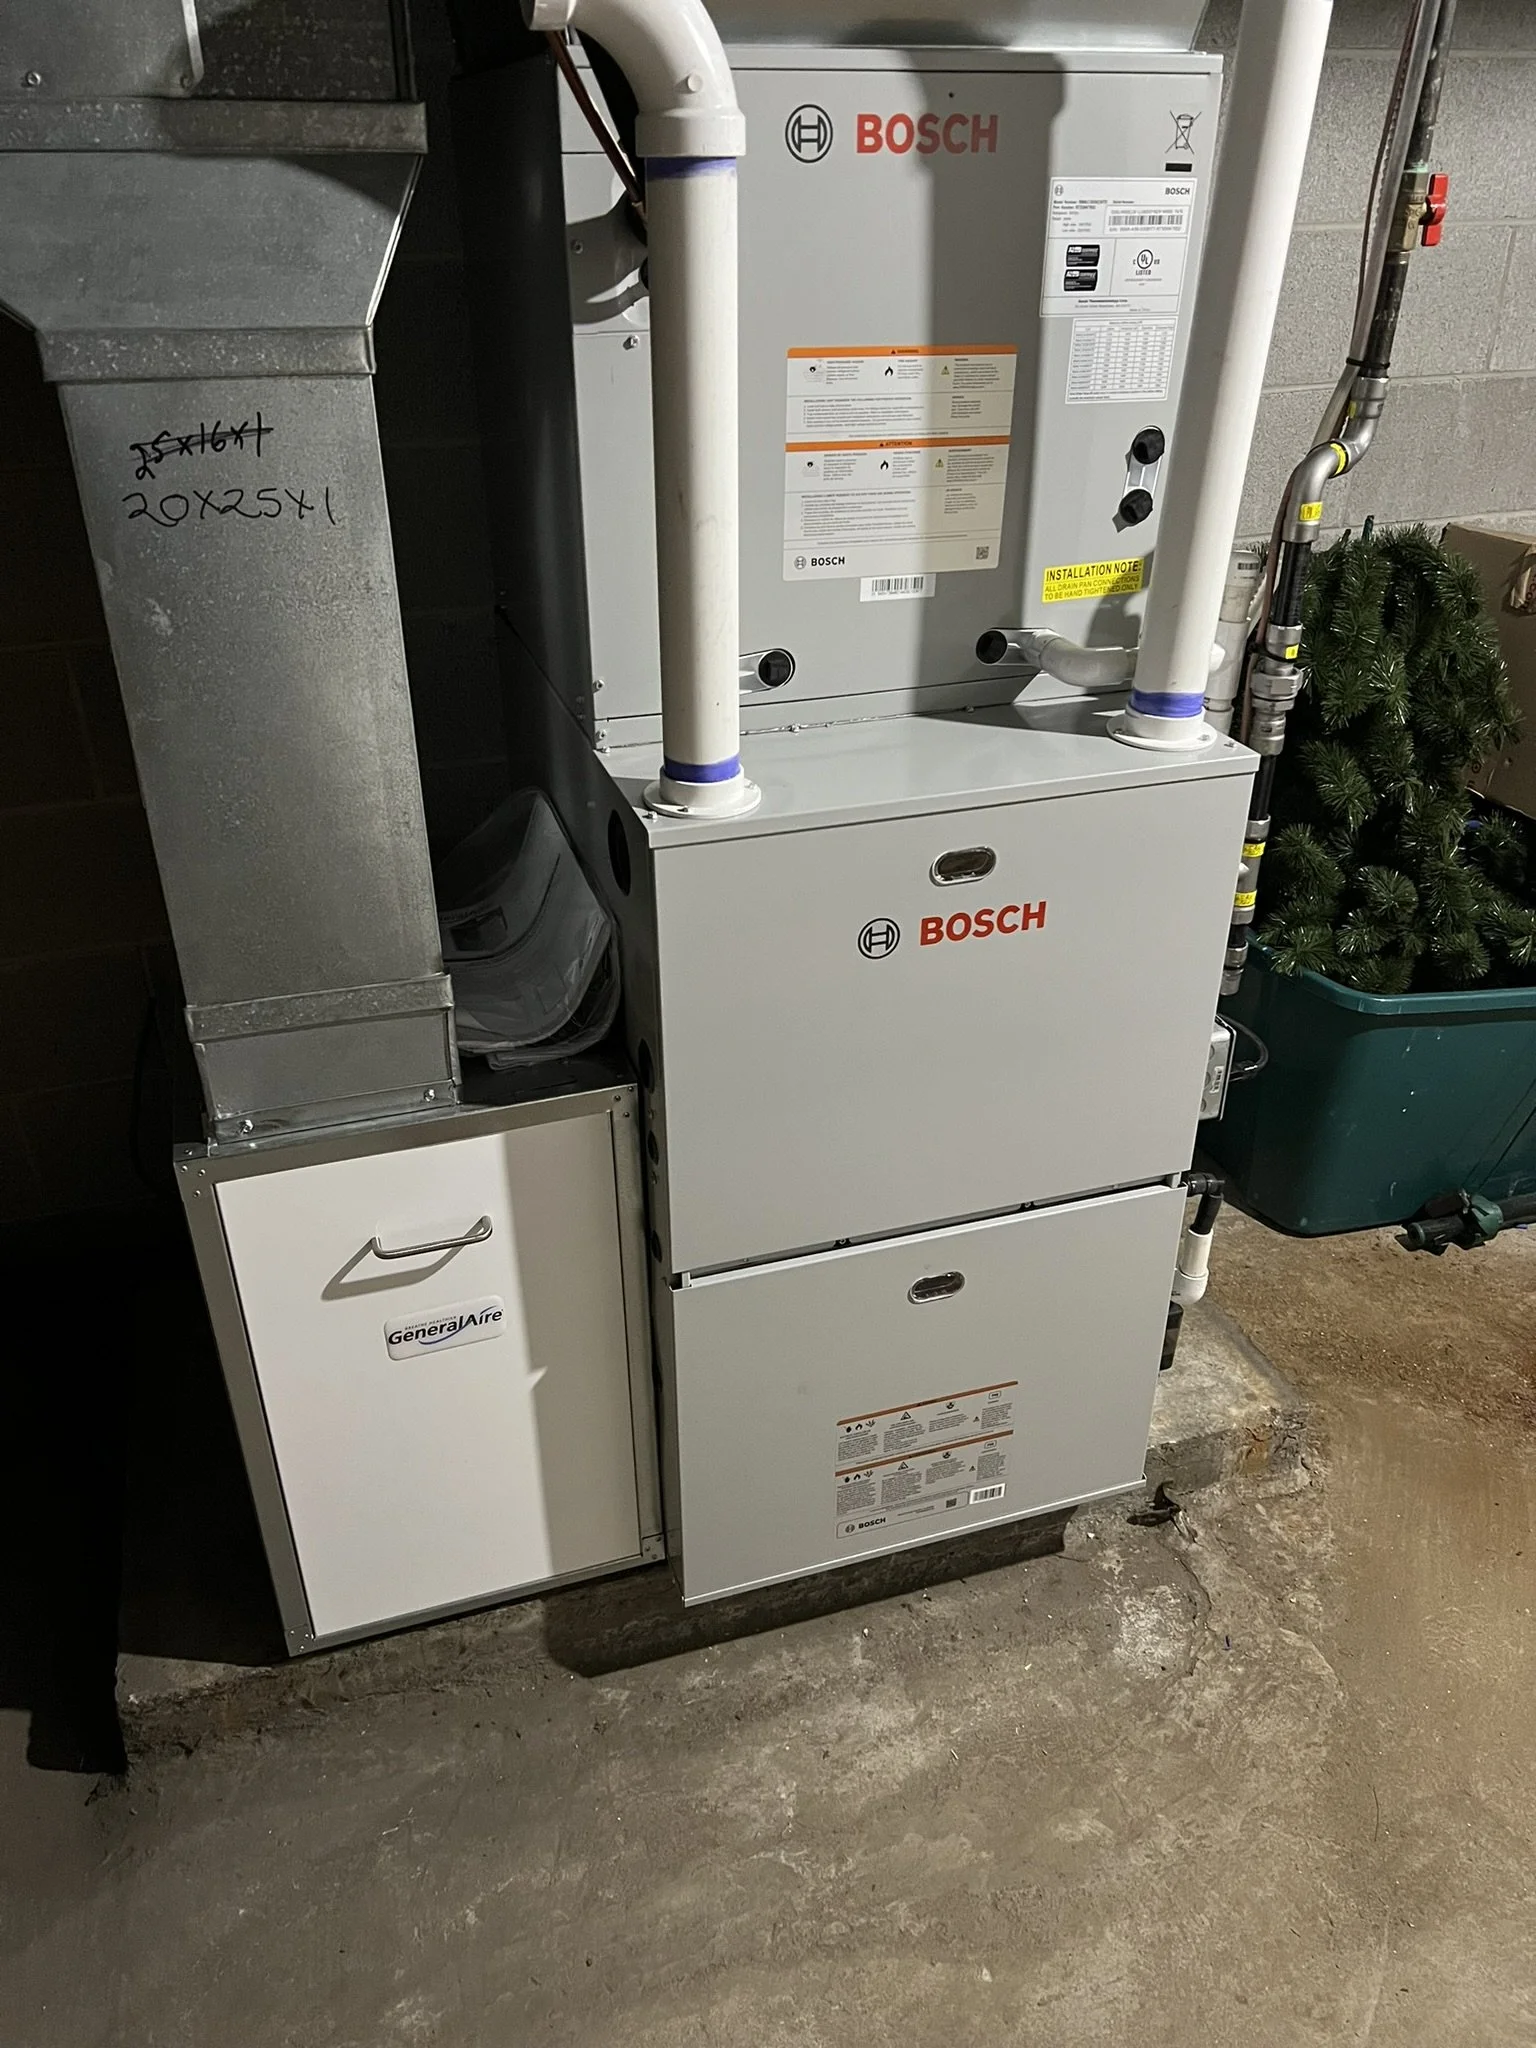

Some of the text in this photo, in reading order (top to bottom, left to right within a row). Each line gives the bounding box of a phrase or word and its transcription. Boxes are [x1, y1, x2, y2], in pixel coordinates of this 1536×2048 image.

[857, 113, 998, 154] BOSCH
[1165, 187, 1190, 196] BOSCH
[811, 556, 845, 567] BOSCH
[1045, 560, 1142, 582] INSTALLATION NOTE:
[1045, 575, 1140, 592] ALL DRAIN PAN CONNECTIONS
[1044, 584, 1138, 601] TO BE HAND TIGHTENED ONLY
[920, 901, 1047, 946] BOSCH
[388, 1310, 502, 1345] GeneralAire
[858, 1517, 887, 1529] BOSCH
